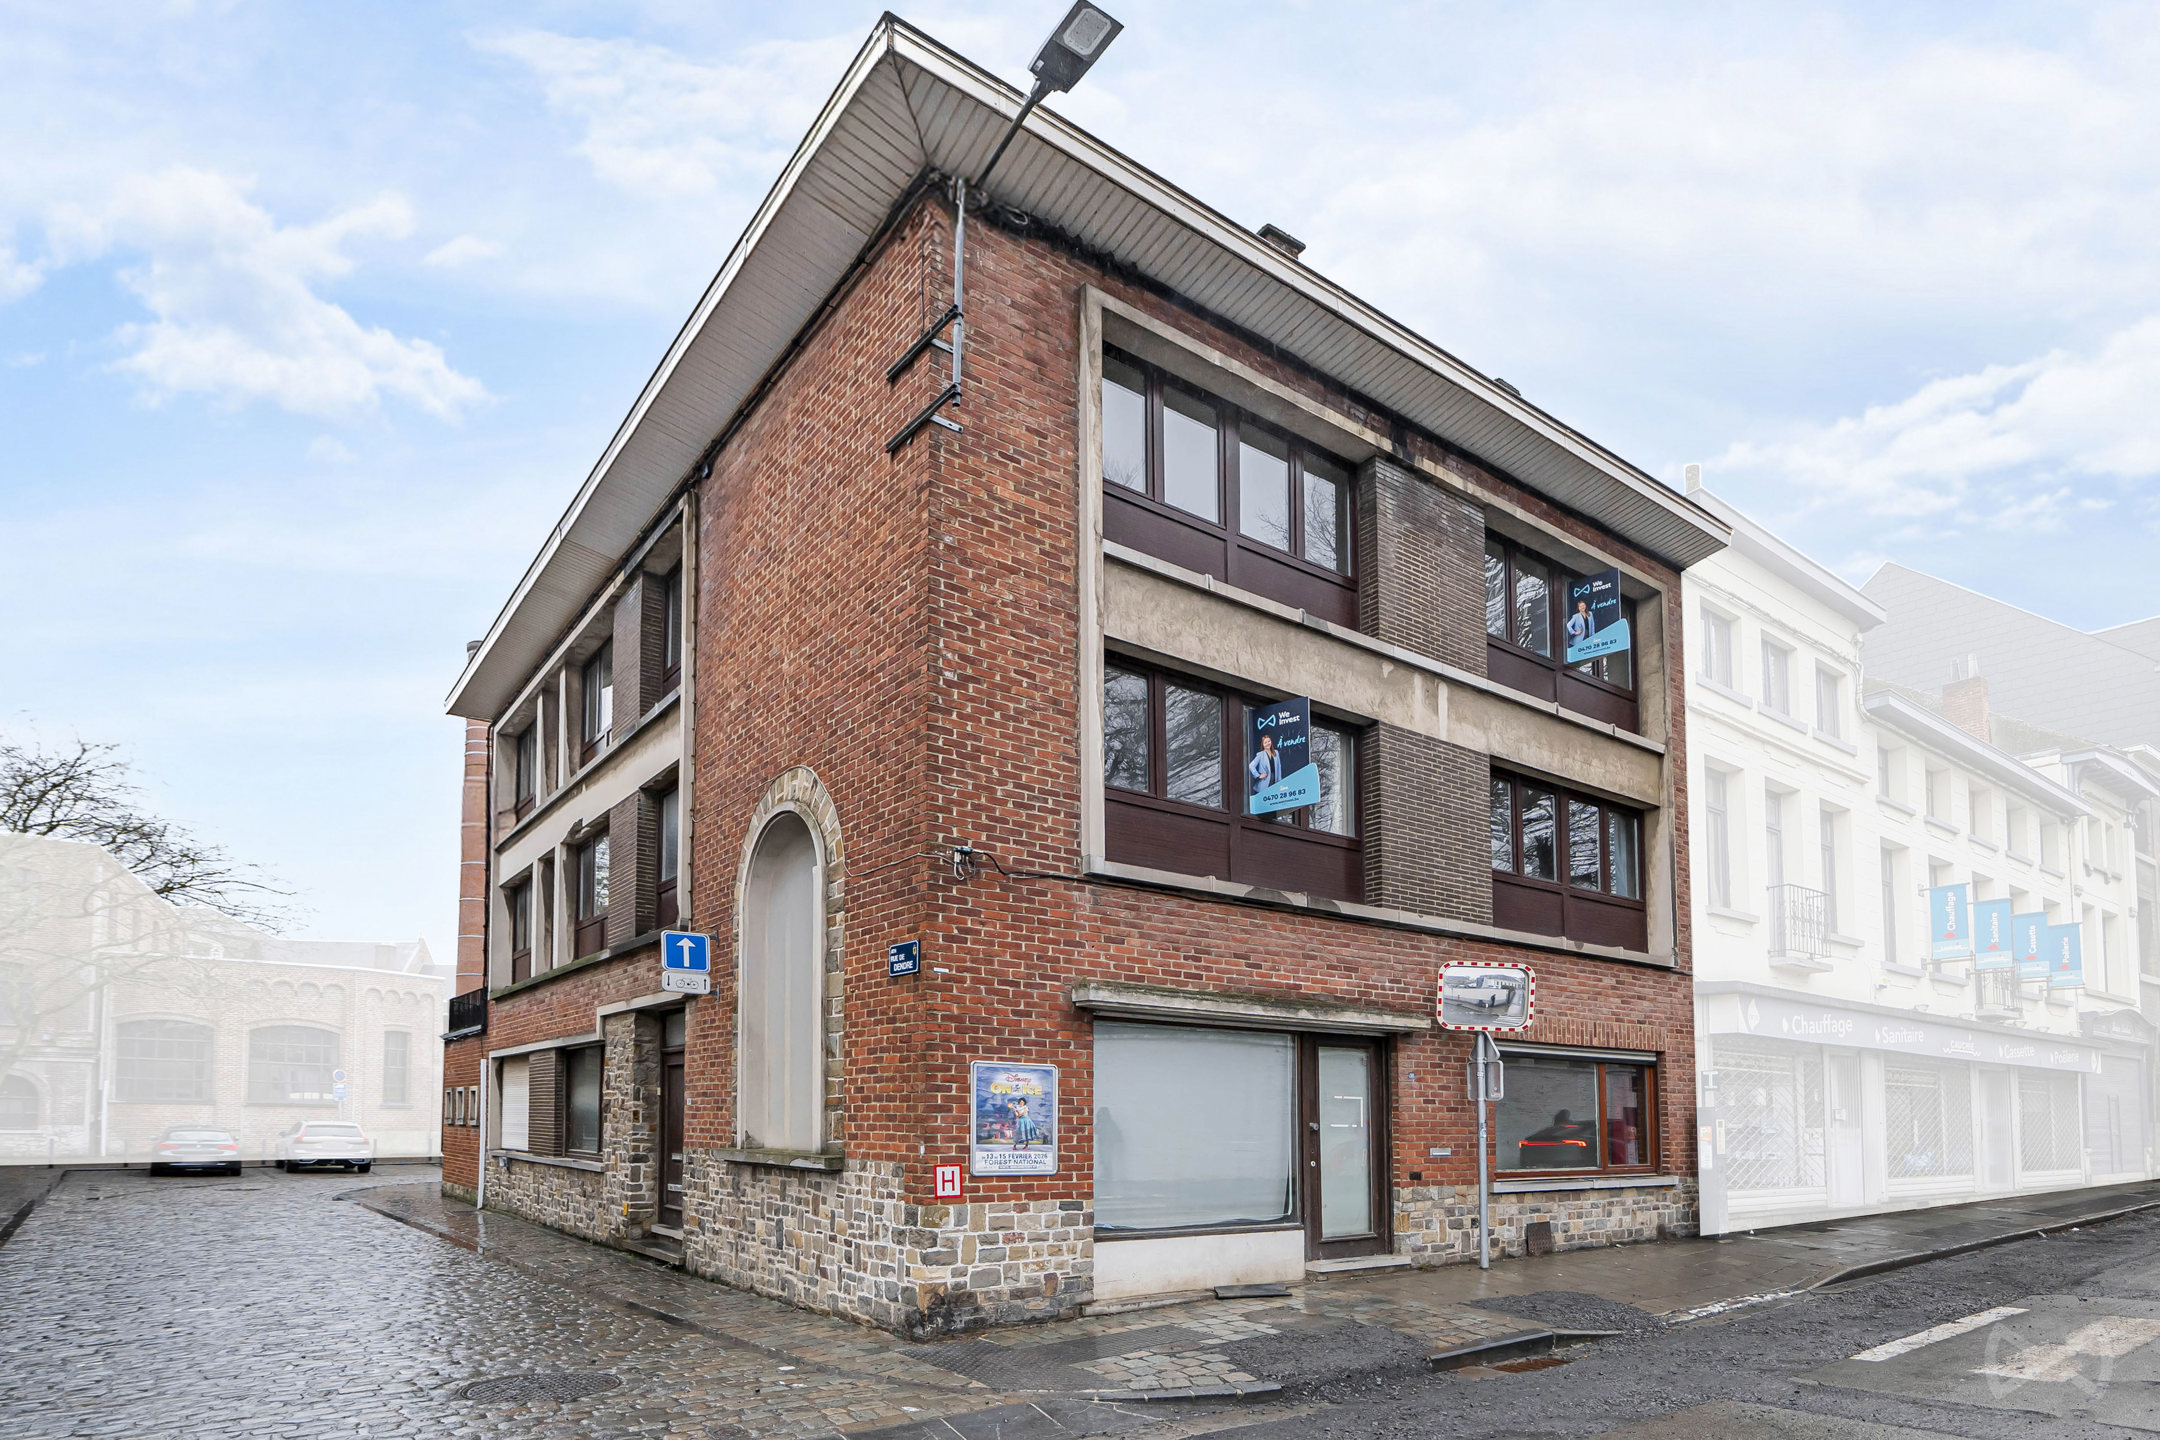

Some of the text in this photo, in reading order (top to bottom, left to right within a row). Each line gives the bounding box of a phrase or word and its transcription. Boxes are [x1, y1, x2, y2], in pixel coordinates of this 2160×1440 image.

[1279, 711, 1290, 719] We
[1283, 734, 1306, 747] vendre
[1263, 794, 1278, 802] 0470
[1945, 891, 1957, 931] Chauffage
[899, 953, 905, 961] DE
[893, 960, 914, 972] DENDRE
[1792, 1013, 1853, 1038] Chauffage
[1881, 1025, 1924, 1043] Sanitaire
[2003, 1044, 2035, 1059] Cassette
[1004, 1072, 1032, 1086] Disney
[990, 1082, 1043, 1096] ON ICE
[942, 1170, 955, 1191] H
